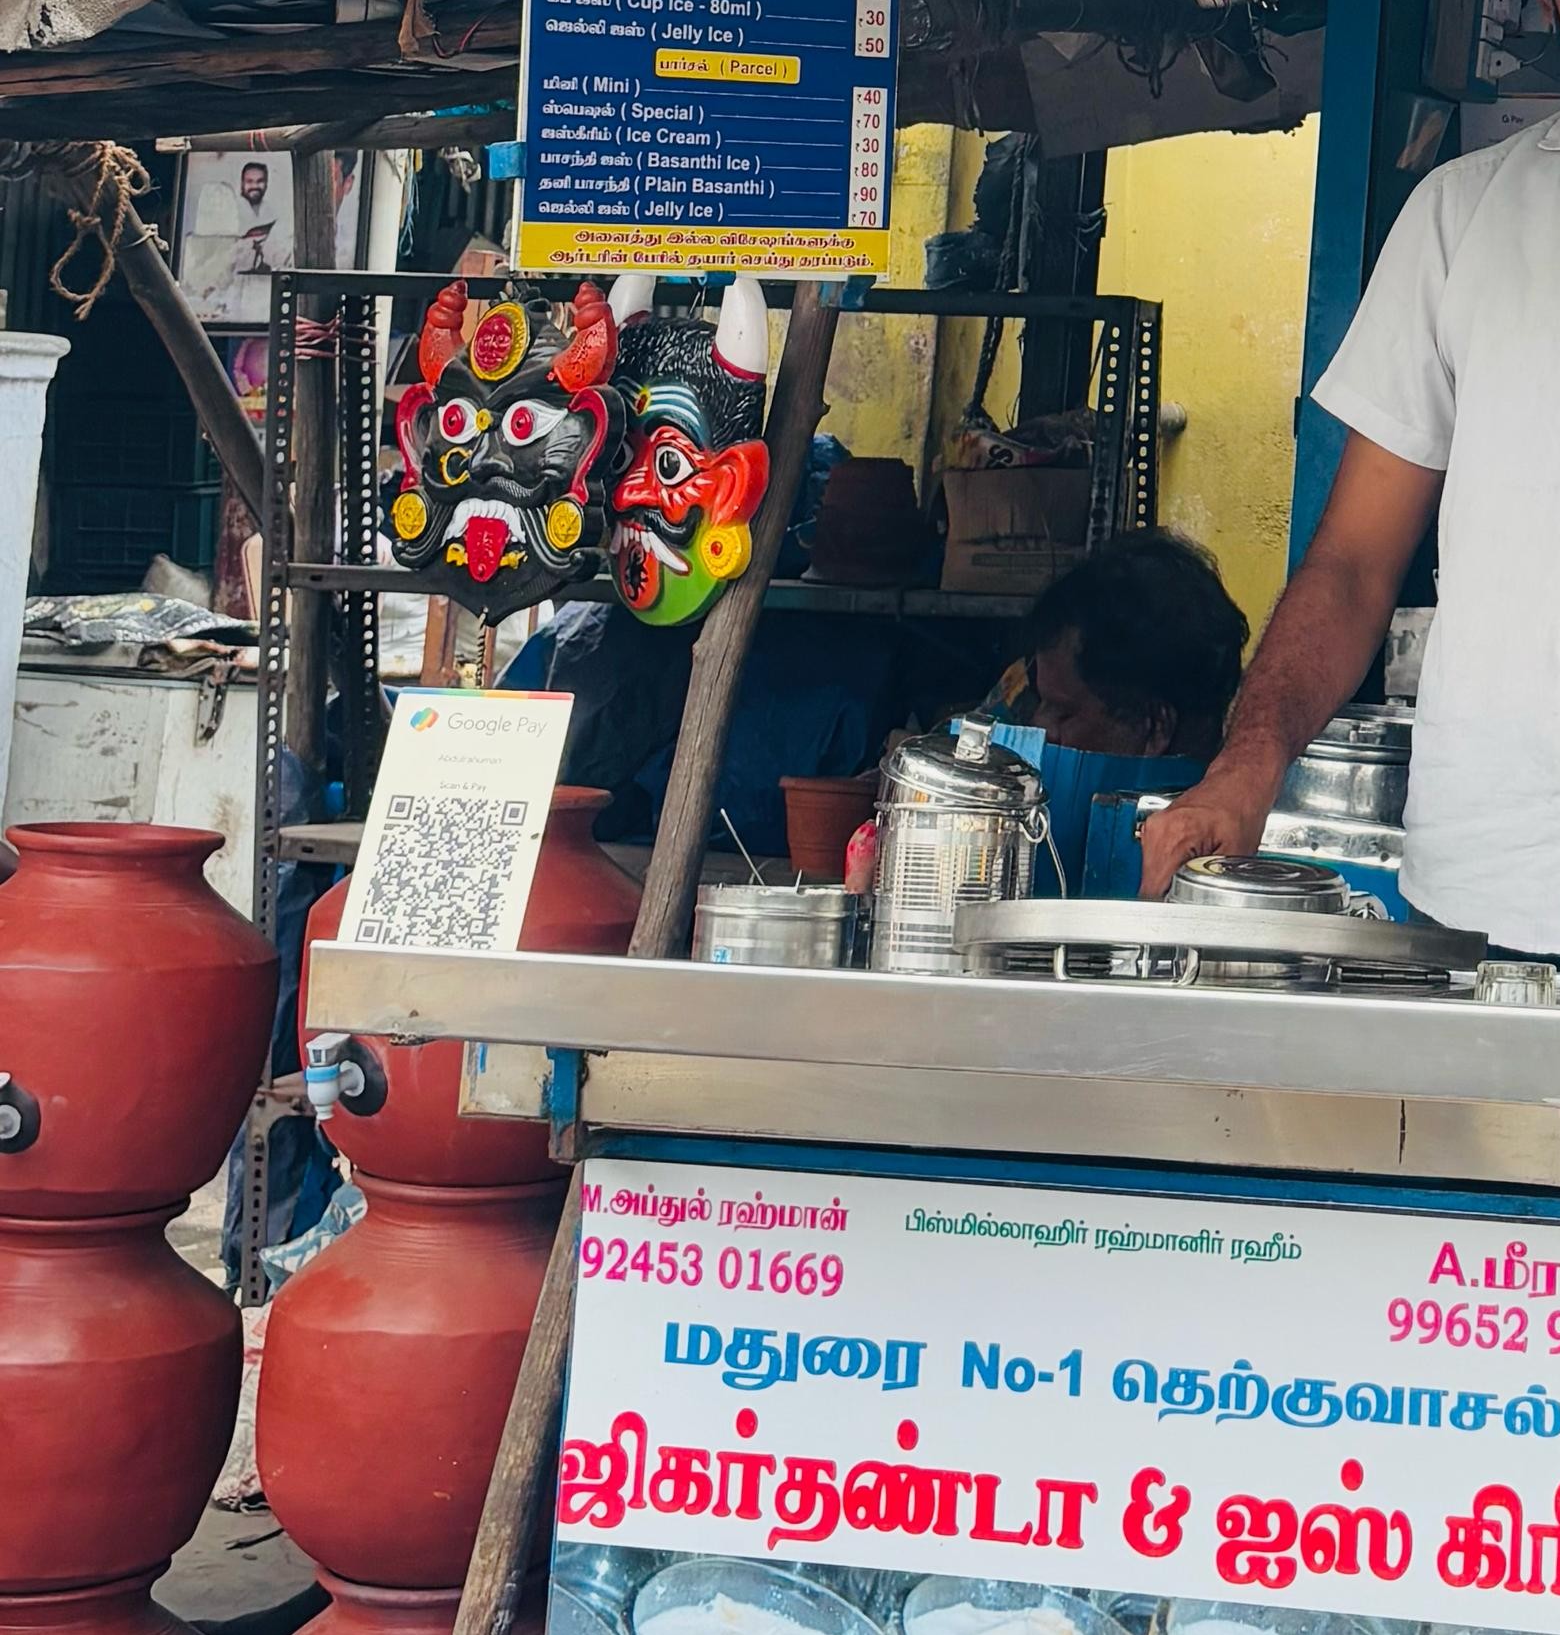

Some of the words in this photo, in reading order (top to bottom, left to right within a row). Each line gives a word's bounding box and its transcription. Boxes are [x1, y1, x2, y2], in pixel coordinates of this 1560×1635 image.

[546, 18, 606, 35] ஜெல்லி
[544, 76, 578, 90] மினி
[543, 99, 615, 118] ஸ்பெஷல்
[540, 150, 597, 167] பாசந்தி
[538, 175, 571, 190] தனி
[575, 176, 630, 193] பாசந்தி
[539, 200, 594, 214] ஜெல்லி
[575, 229, 662, 246] அனைத்து
[667, 231, 715, 245] இல்ல
[447, 712, 512, 735] Google
[516, 716, 548, 737] Pay
[719, 1190, 849, 1233] ரஹ்மான்
[1231, 1229, 1302, 1262] ரஹீம்
[581, 1236, 704, 1287] 92453
[718, 1247, 844, 1298] 01669
[1386, 1297, 1529, 1354] 99652
[664, 1322, 926, 1392] மதுரை
[962, 1341, 1083, 1397] No-1
[559, 1408, 1098, 1550] ஜிகர்தண்டா
[1121, 1466, 1191, 1557] &
[1216, 1458, 1412, 1588] ஐஸ்
